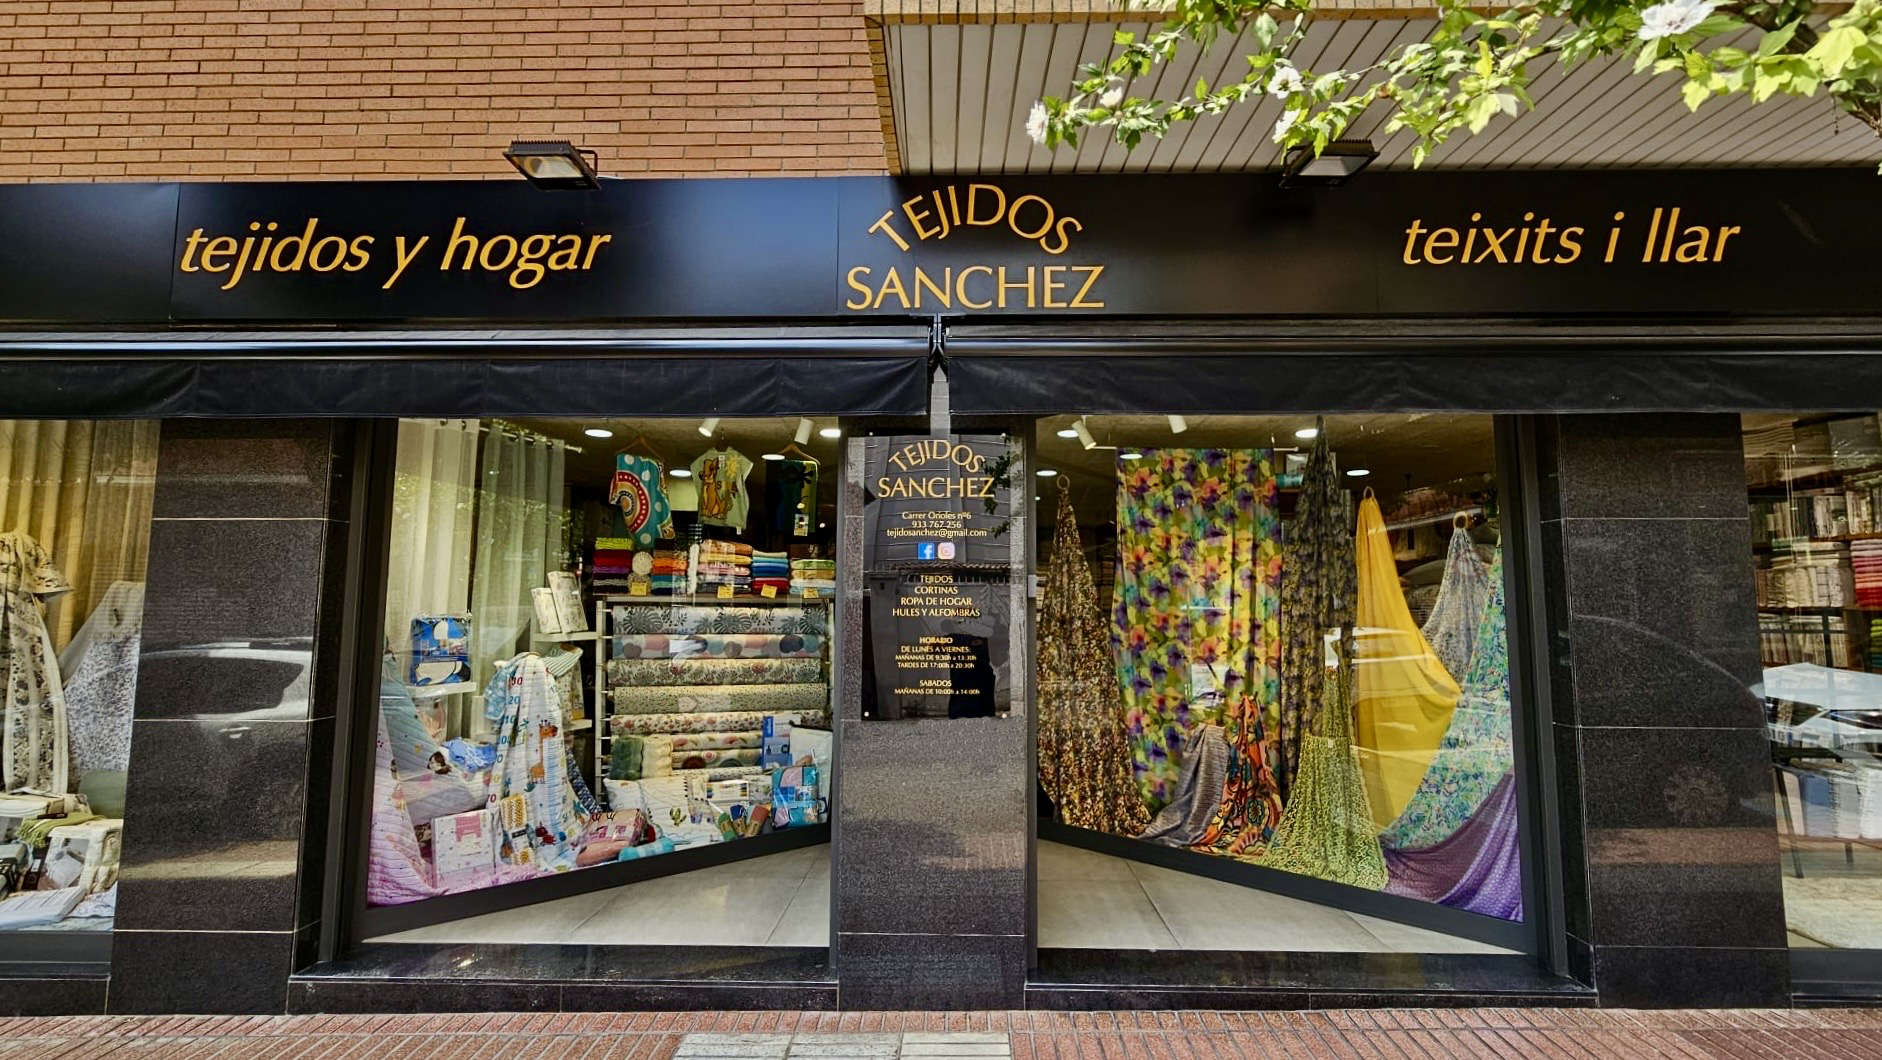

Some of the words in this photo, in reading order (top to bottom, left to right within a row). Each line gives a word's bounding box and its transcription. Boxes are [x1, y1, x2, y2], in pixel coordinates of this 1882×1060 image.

[867, 183, 1083, 255] TEJIDOS
[1402, 212, 1585, 265] teixits
[1603, 210, 1626, 264] i
[1641, 207, 1742, 264] llar
[180, 217, 375, 290] tejidos
[382, 235, 429, 290] y
[440, 216, 612, 290] hogar
[846, 265, 1105, 310] SANCHEZ
[888, 439, 986, 473] TEJIDOS
[878, 476, 995, 498] SANCHEZ
[902, 511, 926, 520] Carrer
[927, 511, 957, 520] Orioles
[911, 520, 927, 528] 933
[929, 520, 944, 528] 767
[946, 520, 962, 528] 256
[886, 528, 987, 538] tejidosanchez@gmail.com
[920, 575, 953, 584] TEJIDOS
[914, 586, 958, 594] CORTINAS
[900, 597, 924, 606] ROPA
[925, 597, 938, 606] DE
[939, 597, 973, 606] HOGAR
[892, 608, 920, 617] HULES
[921, 608, 928, 617] Y
[928, 608, 980, 617] ALFOMBRAS
[919, 636, 954, 644] HORARIO
[901, 645, 911, 653] DE
[911, 645, 934, 653] LUNES
[934, 645, 941, 653] A
[895, 653, 925, 661] MAÑANAS
[926, 653, 935, 661] DE
[897, 661, 920, 669] TARDES
[920, 661, 929, 669] DE
[919, 679, 953, 687] SABADOS
[894, 687, 925, 695] MAÑANAS
[925, 687, 934, 695] DE
